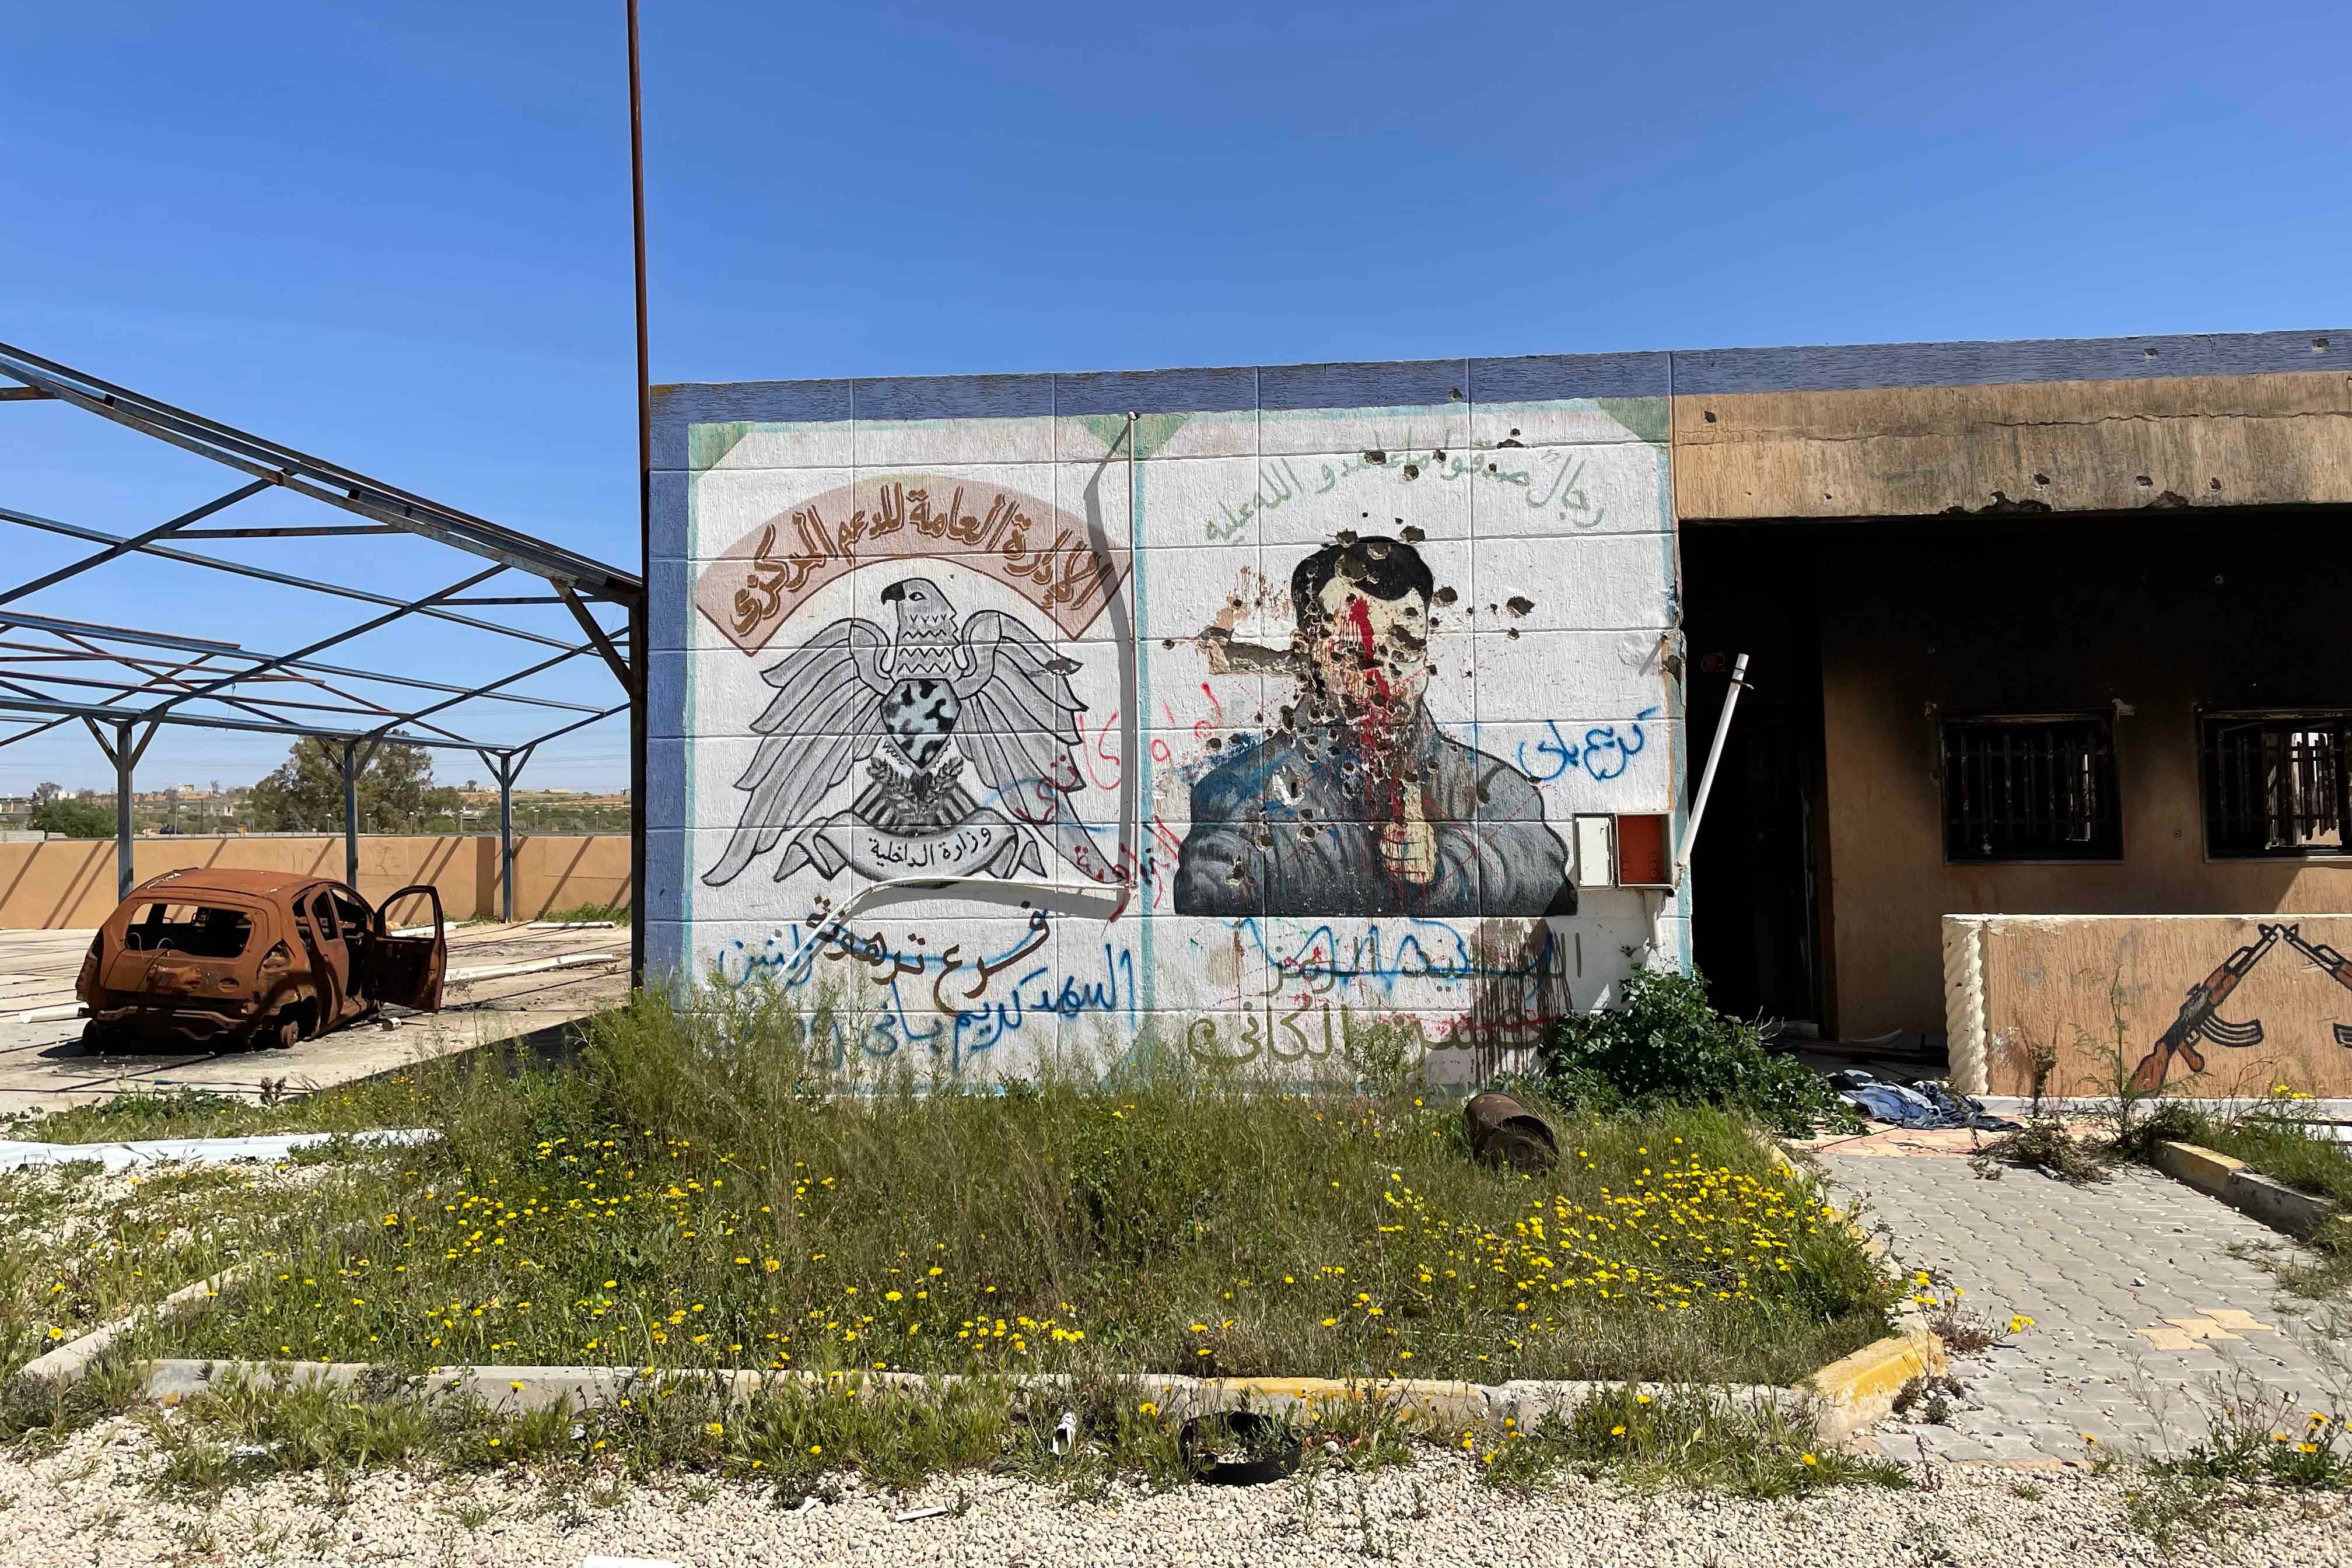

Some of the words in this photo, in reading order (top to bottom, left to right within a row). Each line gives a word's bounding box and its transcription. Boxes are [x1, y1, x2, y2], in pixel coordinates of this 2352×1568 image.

[838, 481, 905, 568] للدعم
[905, 485, 1020, 553] العامة
[867, 837, 935, 867] الداخلية
[937, 827, 992, 862] وزارة
[805, 895, 926, 985] ترهونة
[933, 899, 1051, 1016] فرع
